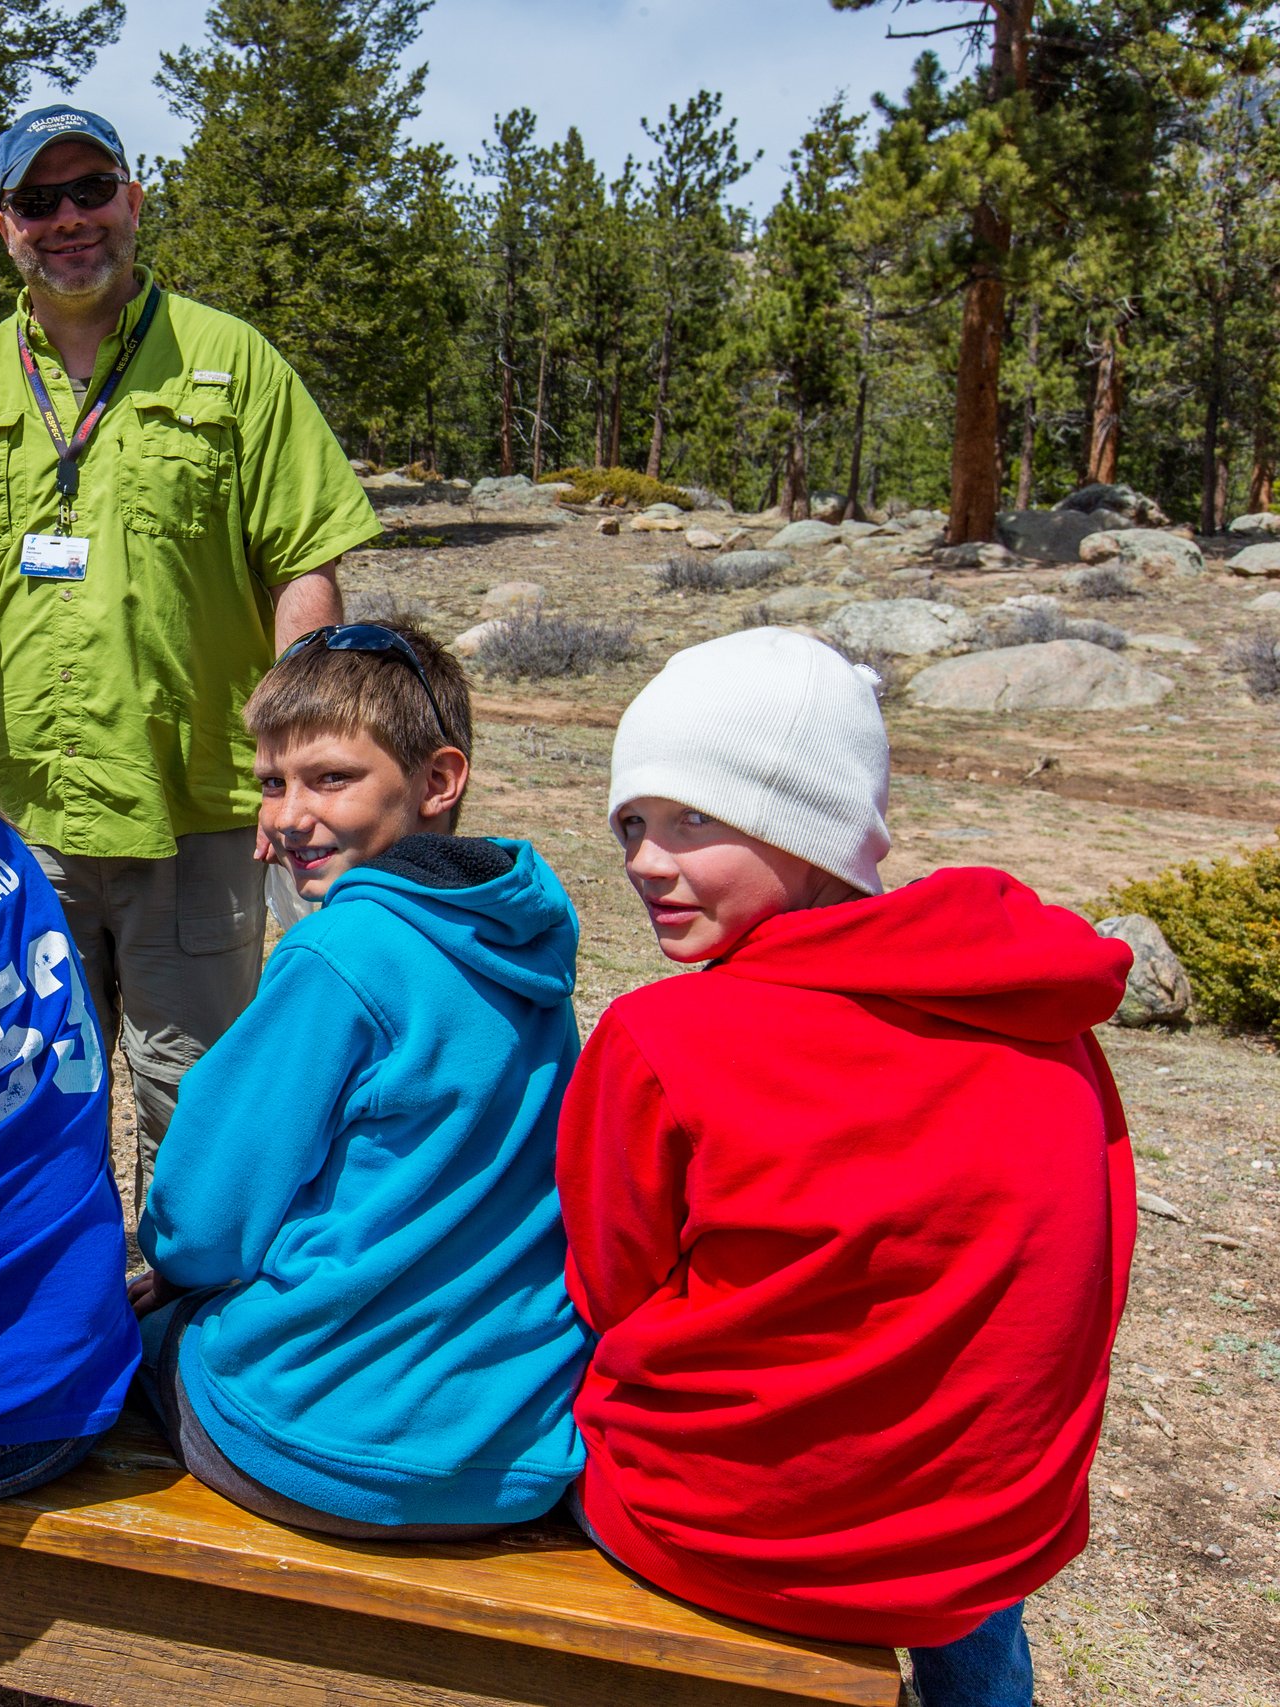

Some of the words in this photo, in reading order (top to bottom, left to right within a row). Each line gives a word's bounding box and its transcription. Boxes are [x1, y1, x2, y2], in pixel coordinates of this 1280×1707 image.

[26, 114, 87, 132] YELLOWSTONE
[116, 339, 139, 372] RESPECT
[31, 375, 50, 409] HONESTY
[44, 411, 63, 442] RESPECT
[78, 412, 98, 440] CARING
